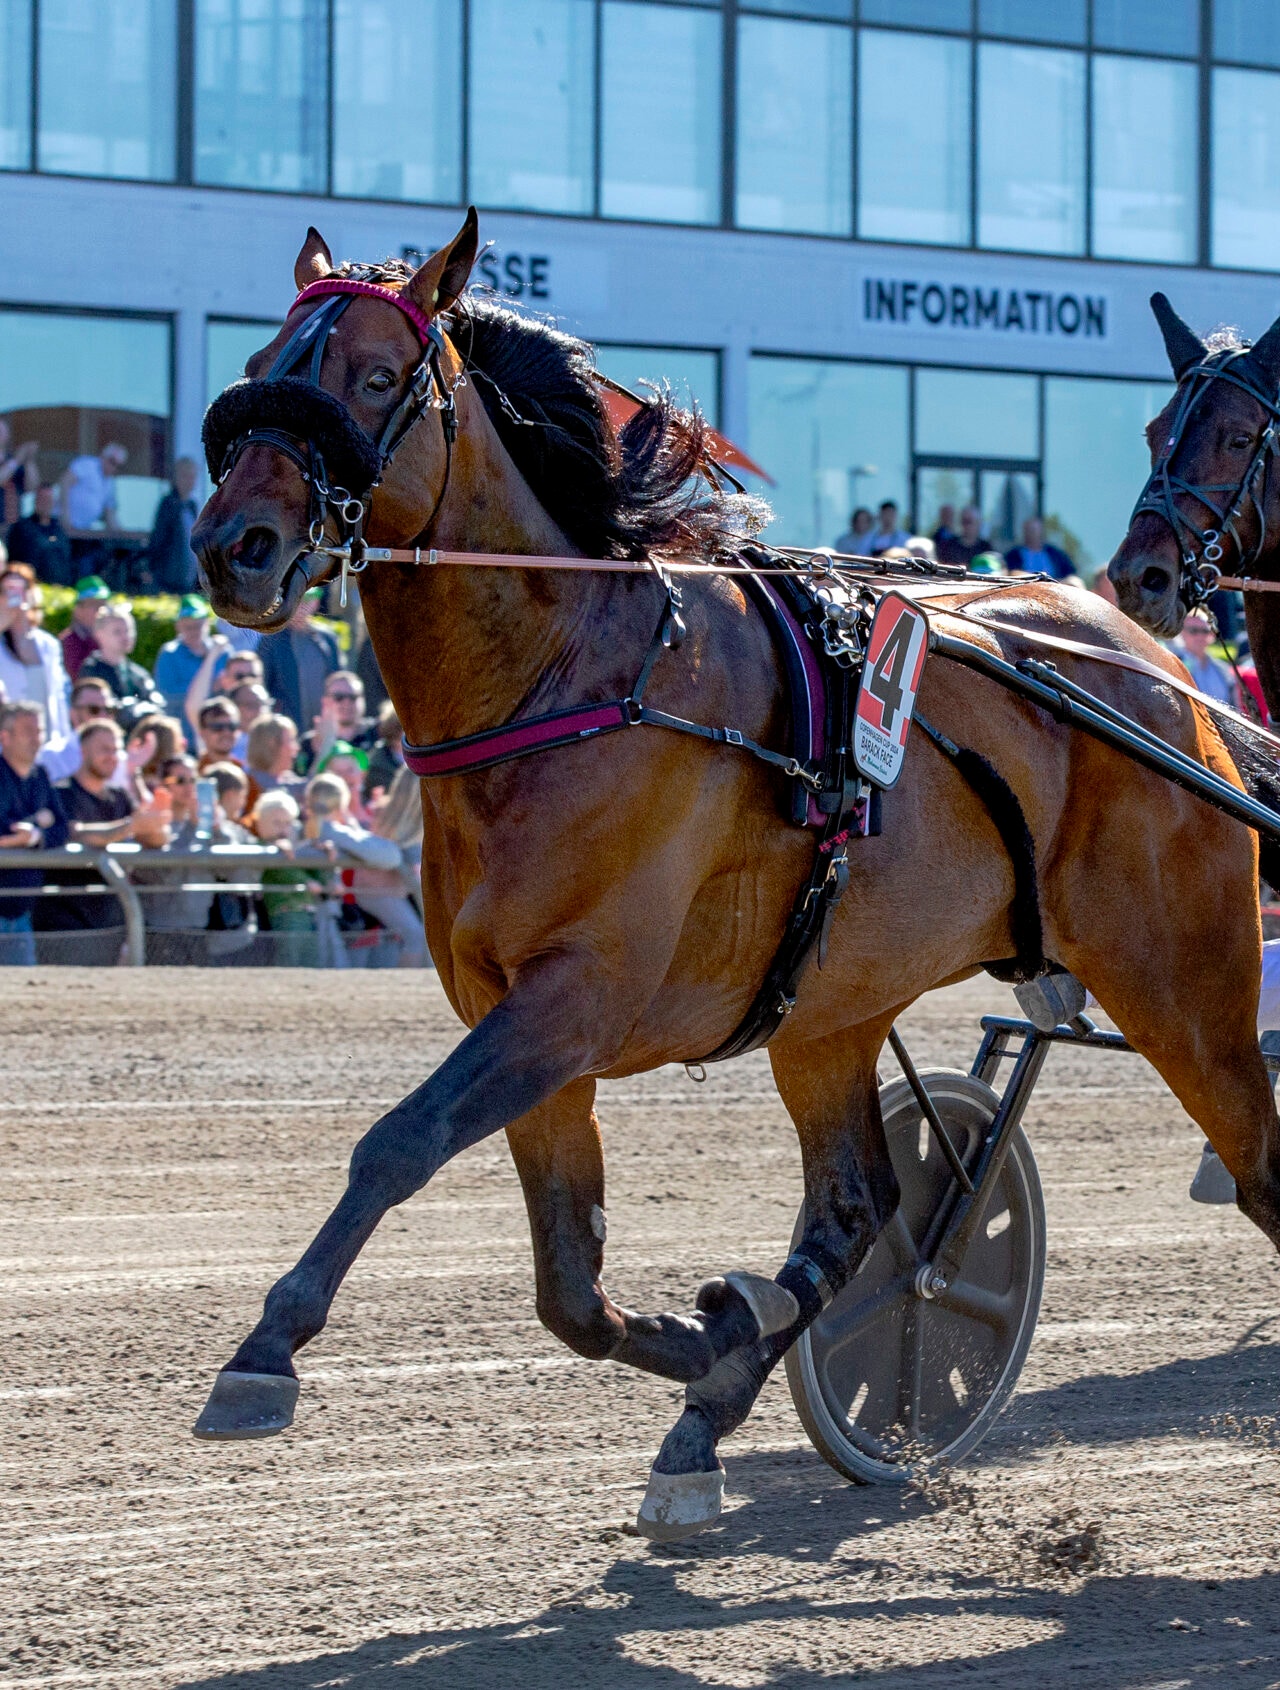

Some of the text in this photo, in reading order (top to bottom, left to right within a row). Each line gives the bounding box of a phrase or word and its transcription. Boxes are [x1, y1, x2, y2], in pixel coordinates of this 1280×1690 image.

[402, 245, 548, 298] PSSE
[864, 278, 1105, 337] INFORMATION
[869, 608, 917, 732] 4
[861, 735, 881, 760] BARACK
[880, 749, 894, 768] FACE
